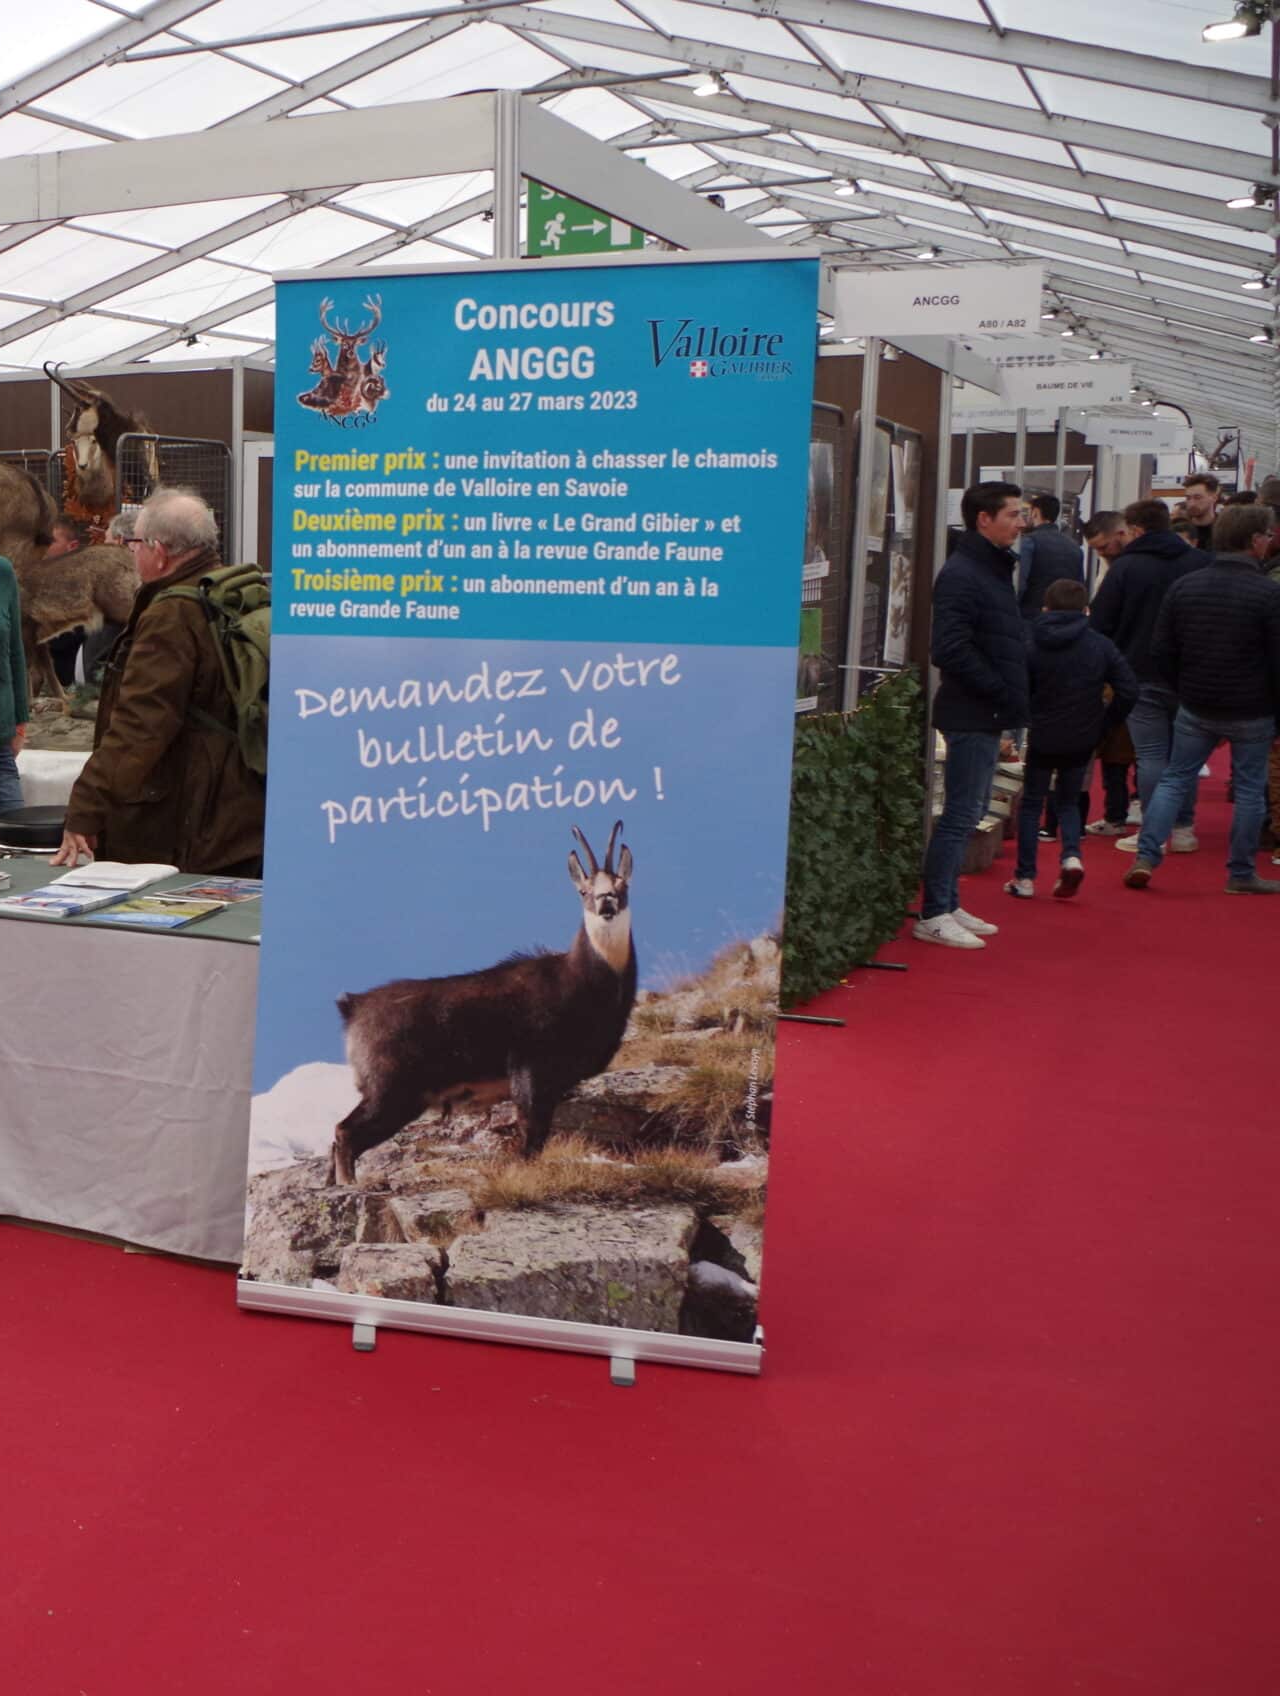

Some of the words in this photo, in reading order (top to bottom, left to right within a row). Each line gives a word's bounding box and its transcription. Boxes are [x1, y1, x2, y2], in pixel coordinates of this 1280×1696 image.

[454, 297, 615, 332] Concours
[912, 295, 960, 306] ANCGG
[1006, 318, 1026, 328] A82
[646, 318, 784, 369] Valloire
[468, 345, 595, 381] ANGGG
[426, 393, 449, 412] du
[453, 393, 477, 412] 24
[481, 397, 504, 412] au
[509, 392, 533, 411] 27
[537, 395, 585, 411] mars
[590, 391, 638, 411] 2023
[294, 447, 380, 472] Premier
[383, 446, 427, 476] prix
[444, 454, 478, 470] une
[483, 450, 570, 470] invitation
[576, 449, 587, 469] à
[591, 449, 667, 469] chasser
[671, 448, 690, 469] le
[694, 448, 778, 469] chamois
[293, 483, 321, 498] sur
[325, 480, 341, 498] la
[344, 481, 429, 498] commune
[433, 478, 457, 497] de
[460, 477, 532, 497] Valloire
[536, 482, 560, 497] en
[565, 477, 629, 497] Savoie
[292, 508, 397, 531] Deuxième
[401, 507, 445, 536] prix
[464, 516, 487, 532] un
[491, 511, 533, 532] livre
[552, 512, 577, 532] Le
[581, 512, 637, 533] Grand
[641, 512, 700, 533] Gibier
[721, 514, 742, 533] et
[291, 543, 312, 558] un
[316, 539, 422, 559] abonnement
[426, 539, 467, 559] d’un
[470, 543, 493, 559] an
[498, 539, 509, 559] à
[514, 539, 531, 560] la
[535, 544, 588, 561] revue
[592, 541, 661, 561] Grande
[665, 542, 724, 562] Faune
[290, 568, 396, 592] Troisième
[400, 569, 444, 598] prix
[463, 578, 486, 594] un
[490, 575, 606, 595] abonnement
[610, 575, 651, 596] d’un
[655, 581, 679, 597] an
[683, 577, 696, 597] à
[701, 577, 720, 598] la
[289, 602, 337, 618] revue
[340, 600, 402, 619] Grande
[406, 601, 461, 620] Faune
[294, 661, 547, 720] Demandez
[560, 652, 682, 693] votre
[357, 713, 553, 769] bulletin
[567, 708, 622, 751] de
[320, 764, 638, 844] participation
